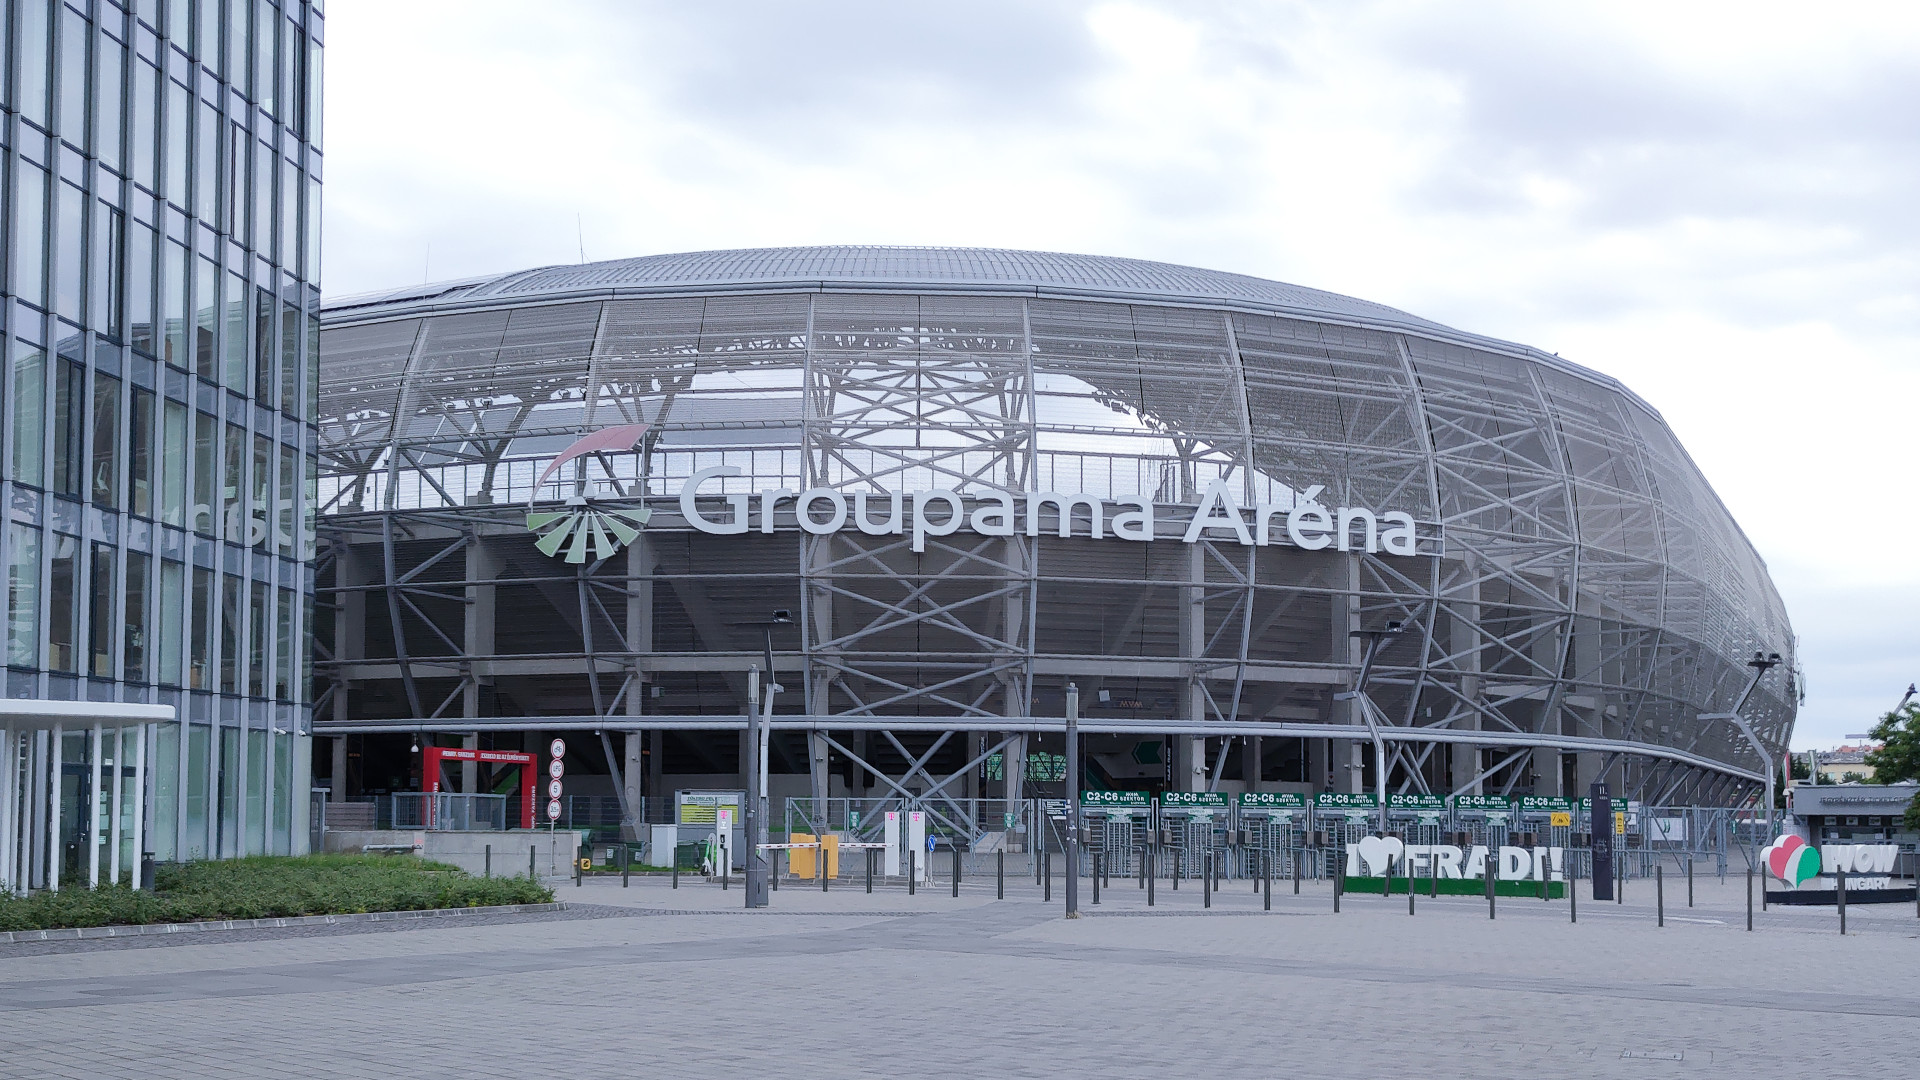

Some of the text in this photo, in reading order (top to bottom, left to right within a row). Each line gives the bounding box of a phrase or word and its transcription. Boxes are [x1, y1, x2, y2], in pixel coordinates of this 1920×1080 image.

[679, 465, 1416, 557] Groupama Aréna
[553, 785, 558, 793] 5
[1086, 791, 1118, 801] C2-C6
[1166, 792, 1197, 802] C2-C6
[1244, 793, 1275, 803] C2-C6
[1319, 794, 1349, 804] C2-C6
[1391, 795, 1418, 804] C2-C6
[1459, 796, 1486, 805] C2-C6
[1523, 796, 1548, 806] C2-C6
[1346, 843, 1360, 877] I
[1404, 844, 1564, 881] FRADI!
[1821, 844, 1899, 873] WOW
